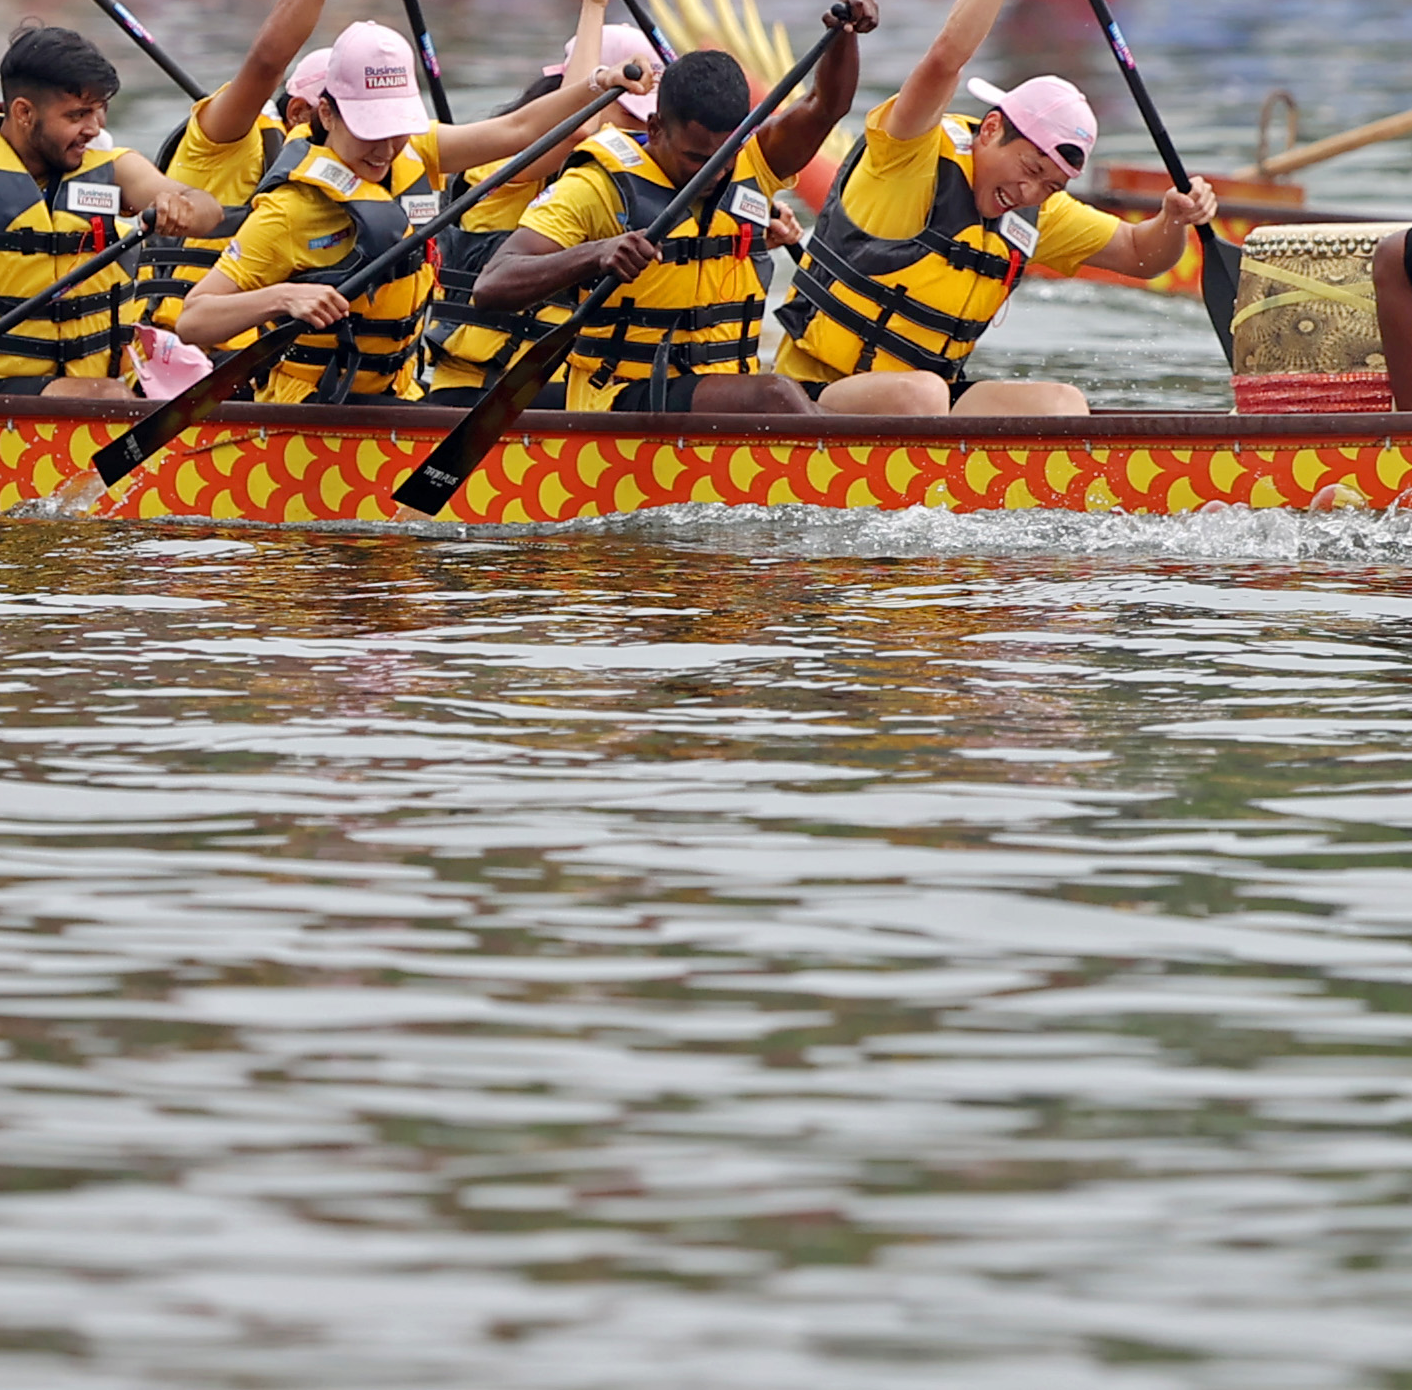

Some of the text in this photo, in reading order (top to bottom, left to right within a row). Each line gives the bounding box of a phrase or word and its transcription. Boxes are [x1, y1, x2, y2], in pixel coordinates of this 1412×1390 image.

[365, 66, 407, 76] Business
[366, 75, 407, 88] TIANJIN
[77, 188, 113, 198] Business
[78, 196, 112, 208] TIANJIN
